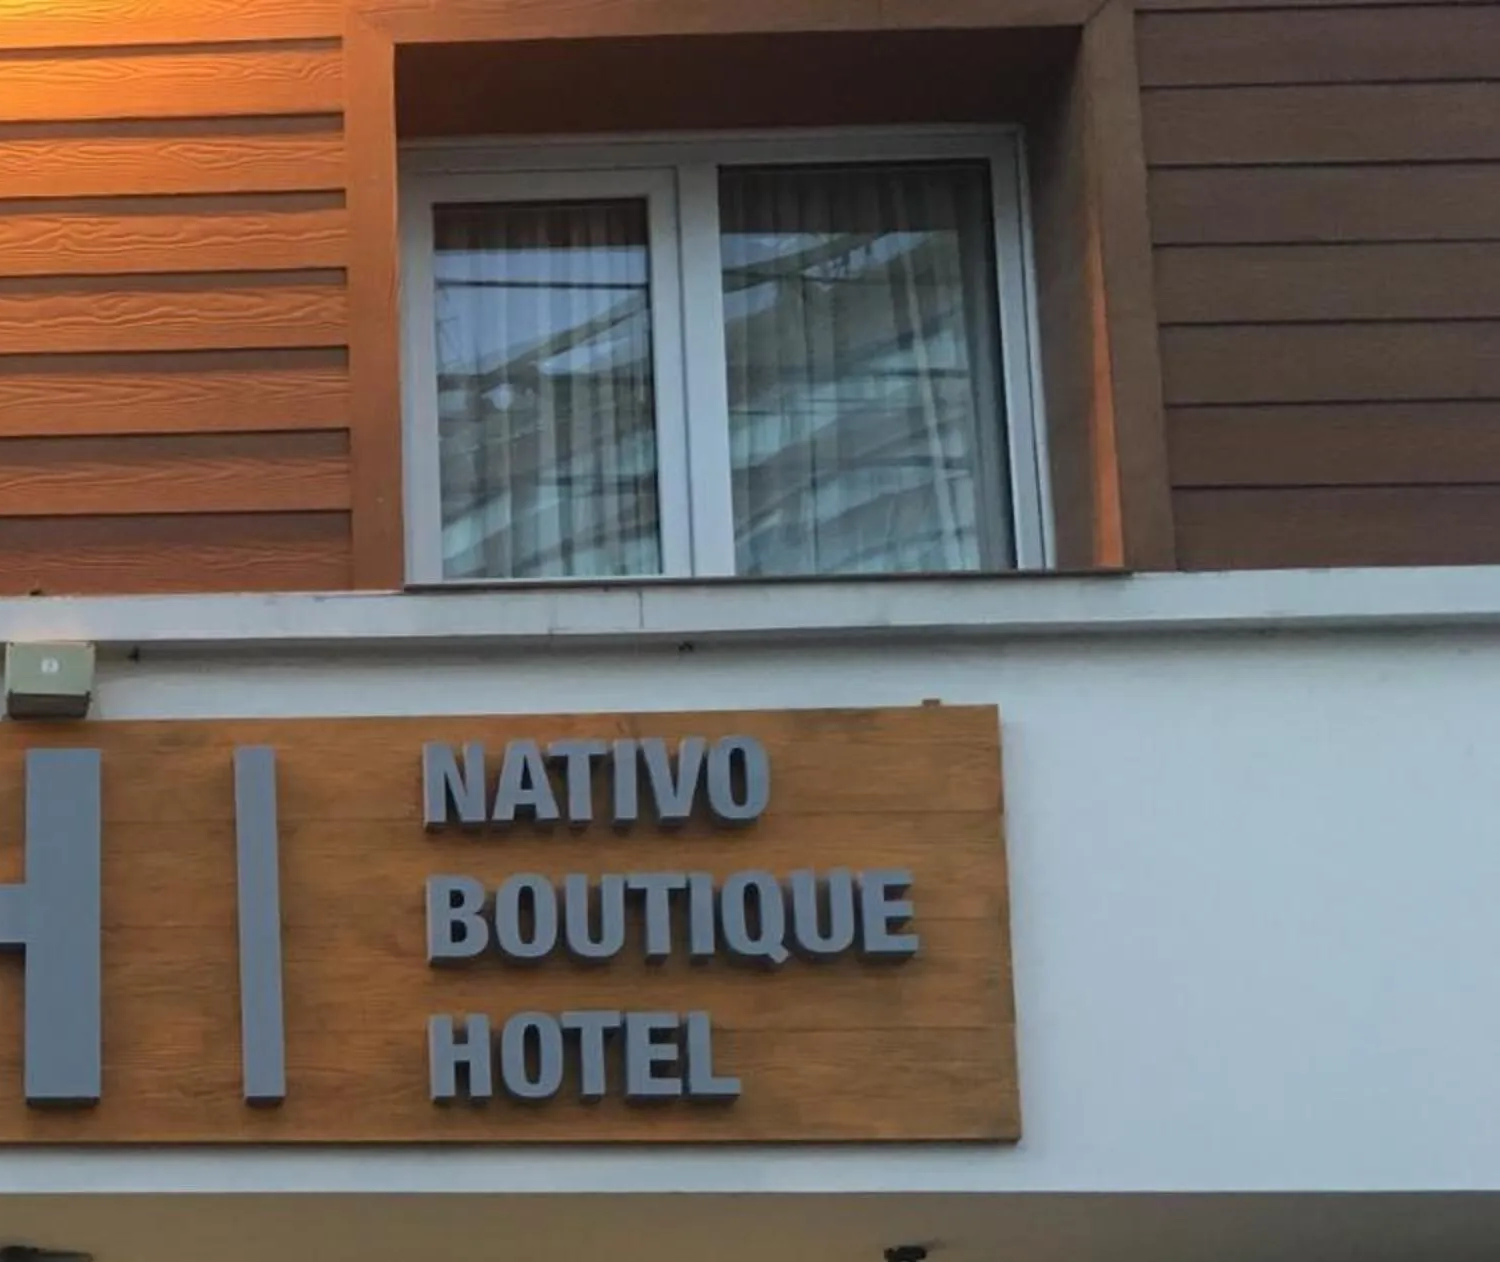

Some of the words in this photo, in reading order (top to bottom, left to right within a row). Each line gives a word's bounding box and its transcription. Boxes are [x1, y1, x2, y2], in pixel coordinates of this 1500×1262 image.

[421, 734, 771, 829] NATIVO
[425, 866, 921, 966] BOUTIQUE
[428, 1010, 743, 1102] HOTEL
